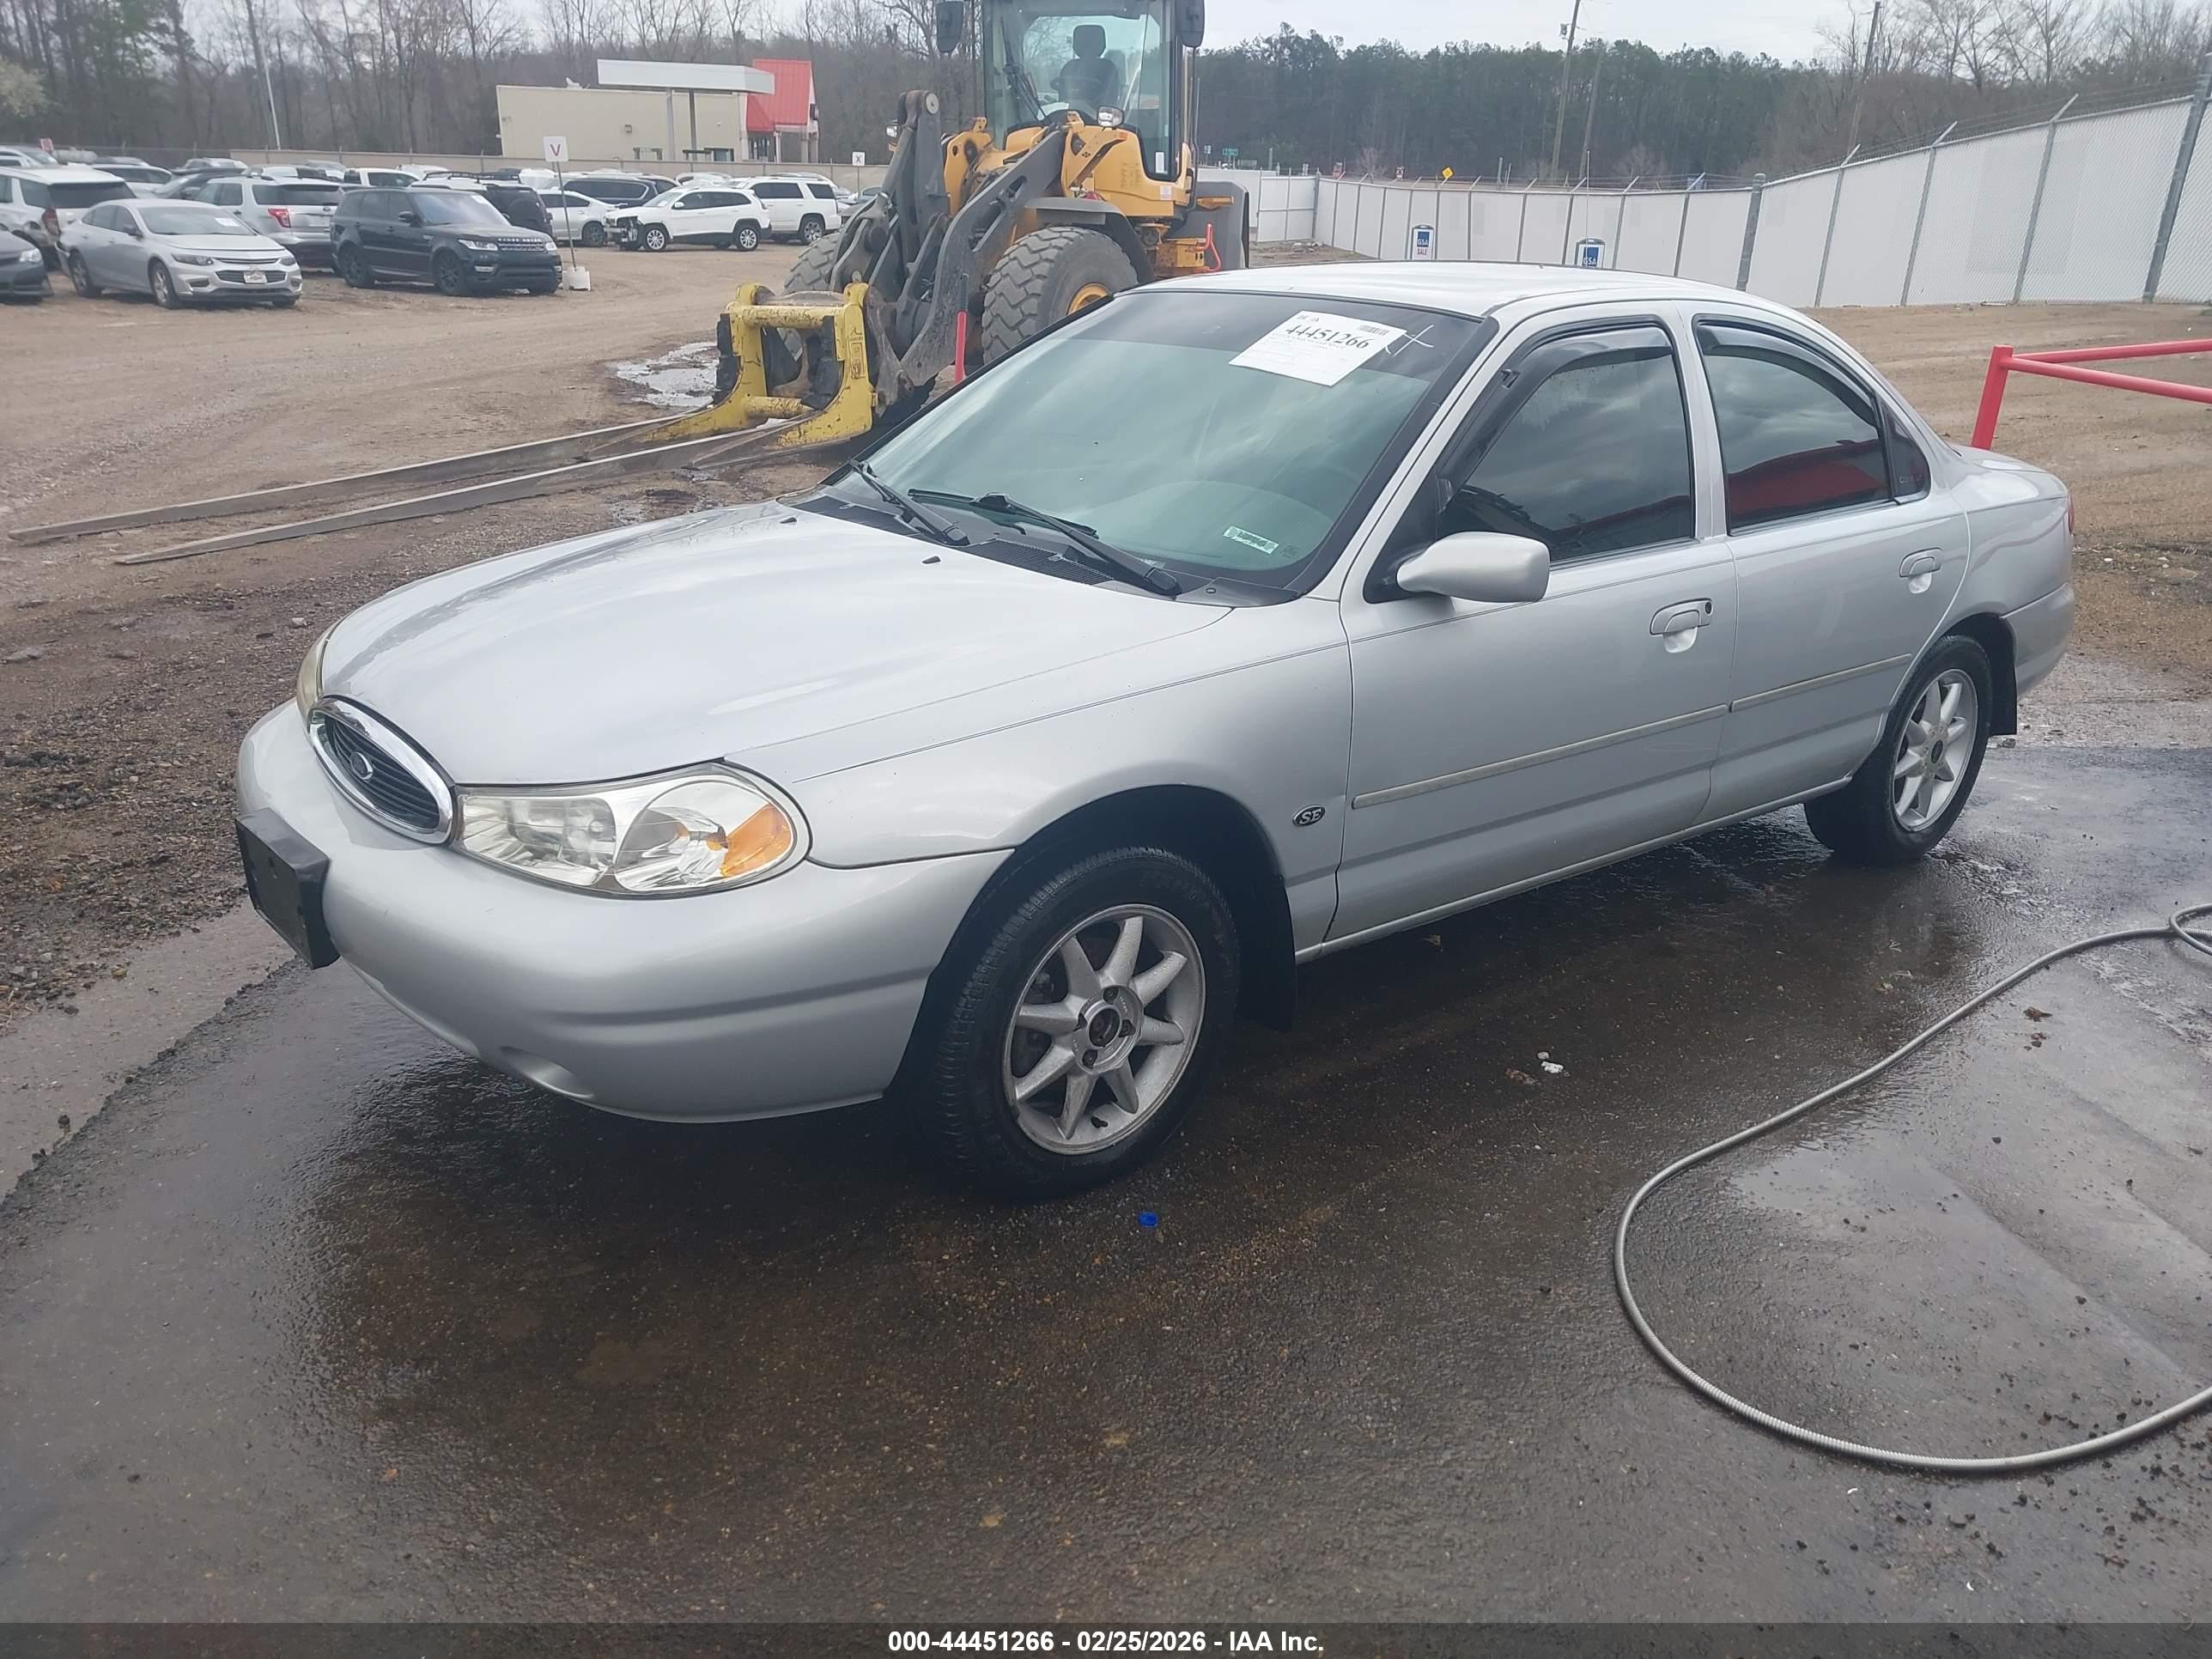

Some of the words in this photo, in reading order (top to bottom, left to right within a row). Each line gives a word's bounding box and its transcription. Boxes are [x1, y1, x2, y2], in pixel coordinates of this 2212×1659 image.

[550, 143, 561, 157] V
[1583, 257, 1596, 265] GSA
[1285, 325, 1375, 349] 44451266
[1298, 808, 1322, 825] SE
